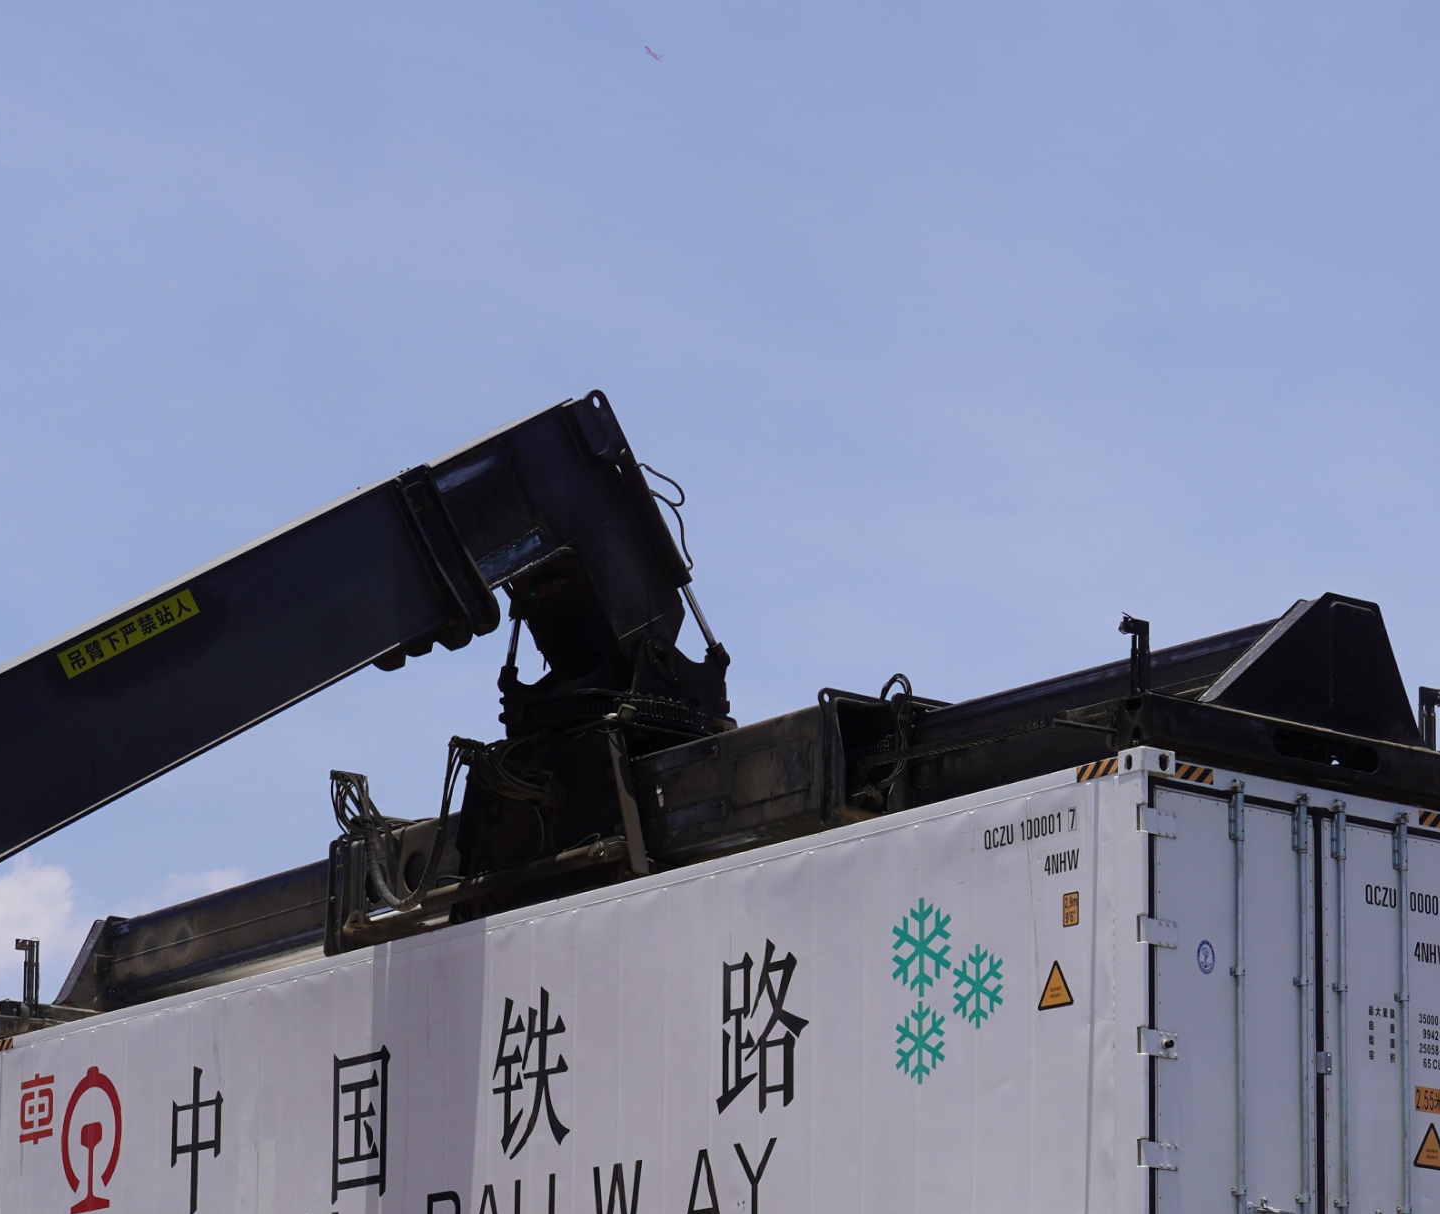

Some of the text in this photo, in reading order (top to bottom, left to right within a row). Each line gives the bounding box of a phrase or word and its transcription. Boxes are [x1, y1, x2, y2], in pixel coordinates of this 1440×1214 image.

[67, 598, 192, 671] 吊臂下严禁站人
[984, 809, 1076, 850] QCZU 100001 7
[1044, 848, 1080, 876] 4NHW
[1365, 884, 1397, 909] QCZU
[1418, 1013, 1439, 1027] 35000
[1422, 1028, 1439, 1041] 9942
[1419, 1042, 1440, 1056] 25058
[1422, 1057, 1432, 1069] 65
